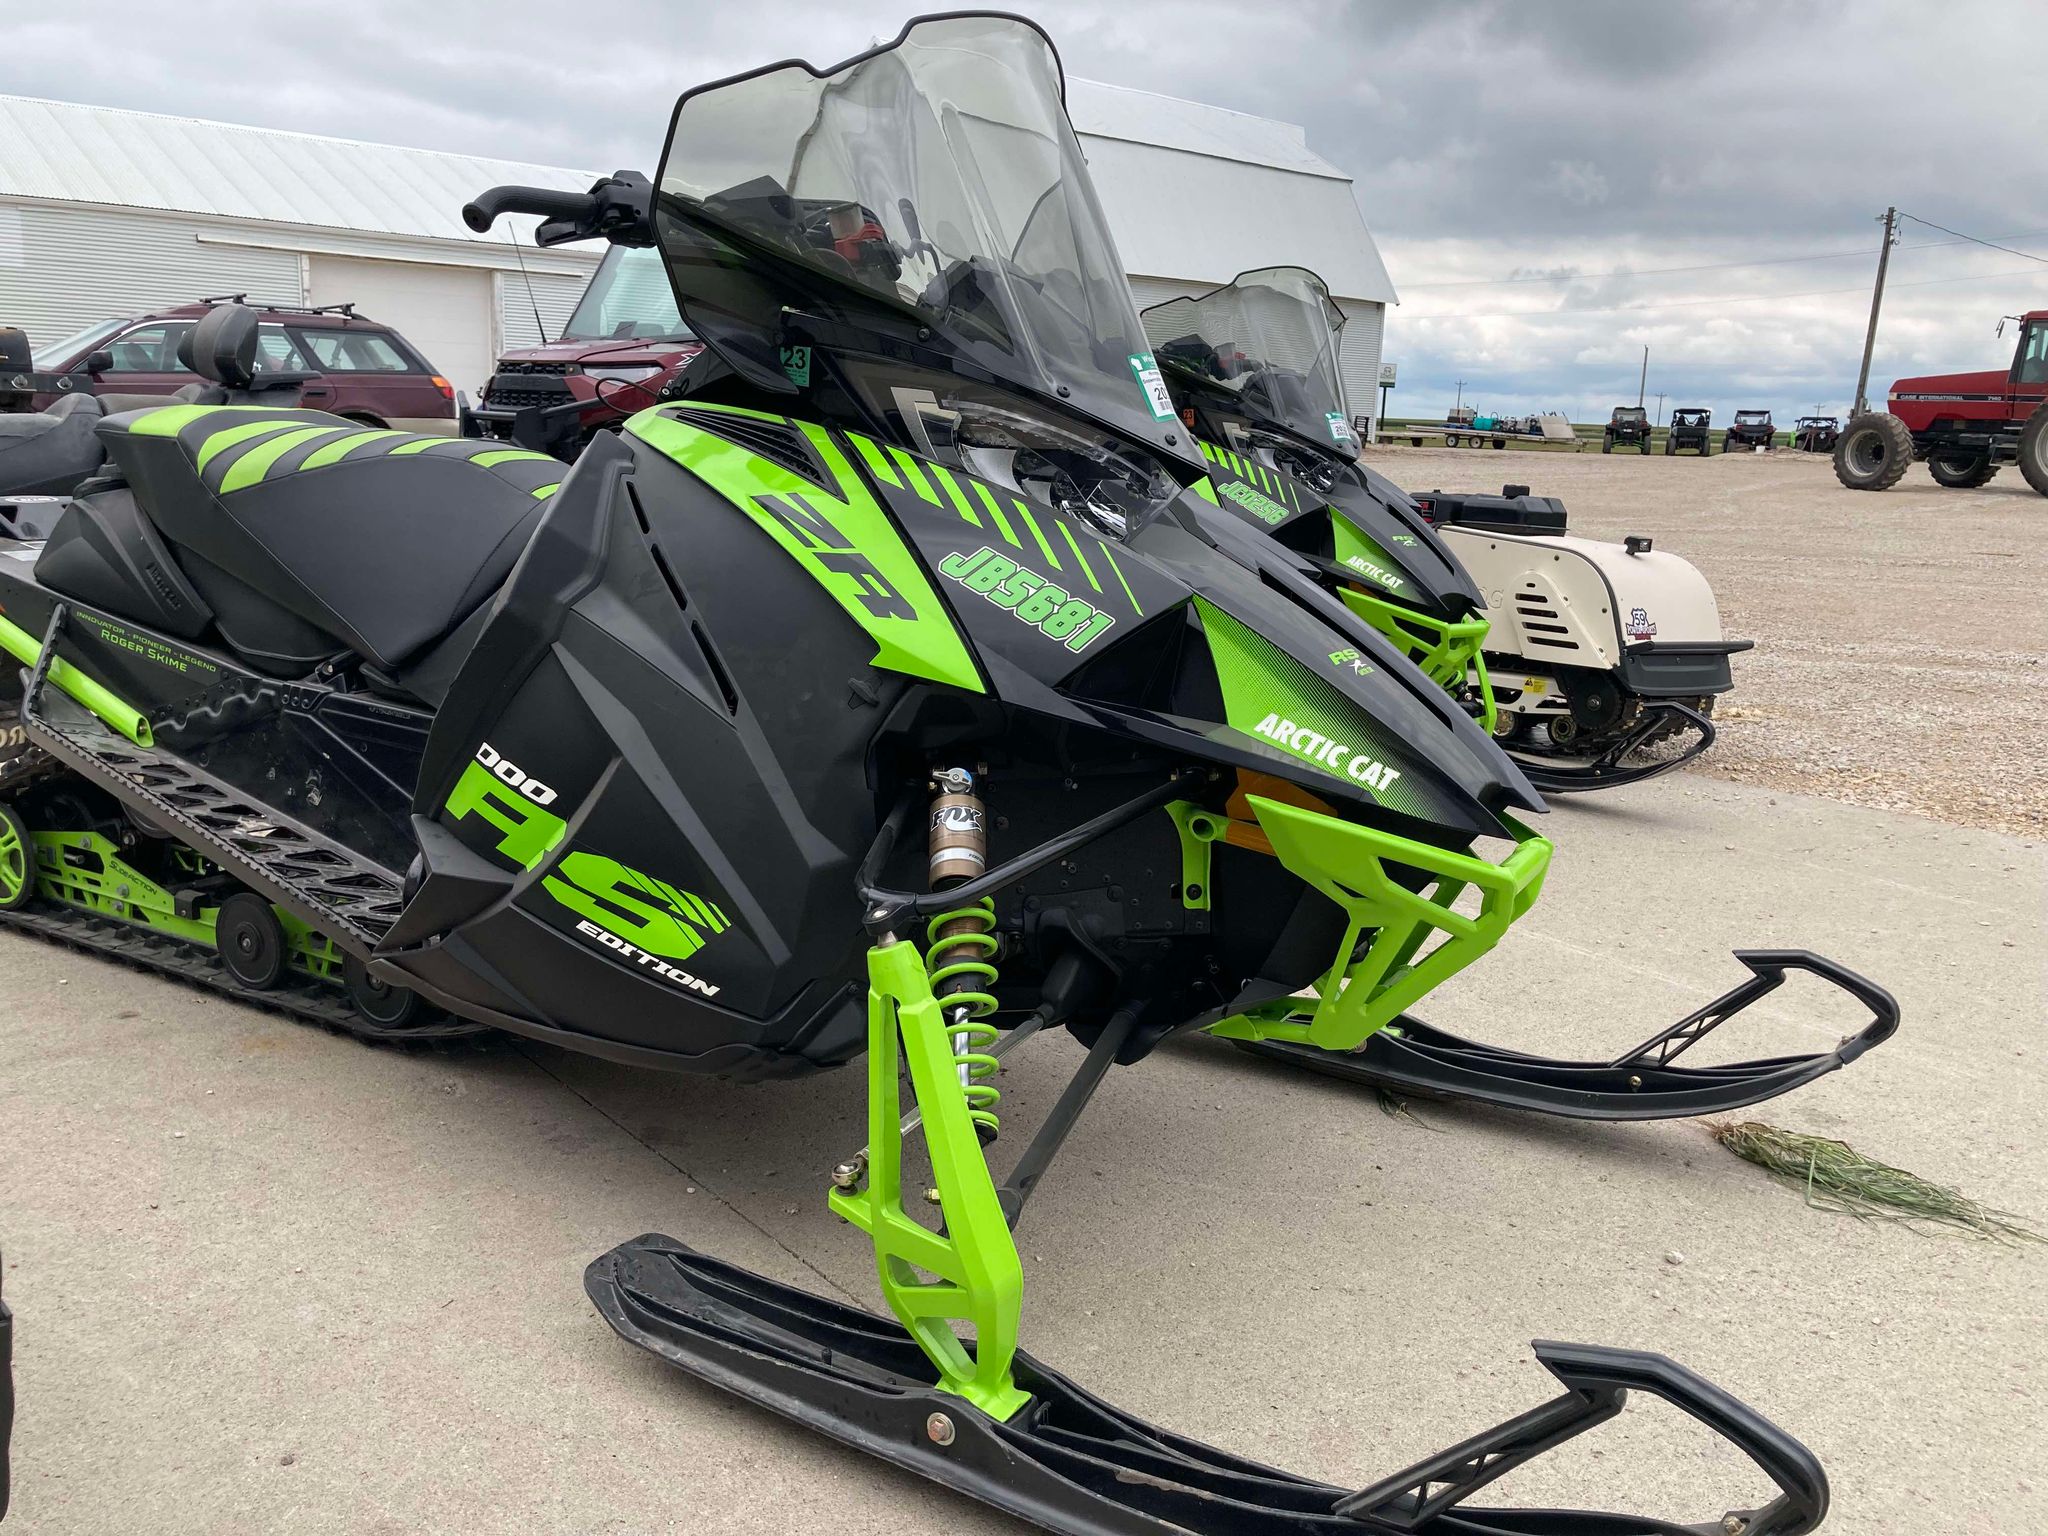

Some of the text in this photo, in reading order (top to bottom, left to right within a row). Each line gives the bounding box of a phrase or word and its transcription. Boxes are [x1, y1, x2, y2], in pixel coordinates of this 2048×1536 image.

[783, 347, 806, 369] 23
[749, 492, 919, 621] ZR
[1346, 555, 1404, 589] ARCTIC CAT
[938, 546, 1115, 653] JB5681
[1634, 613, 1646, 625] 59
[76, 611, 217, 672] INNOVATOR PIONEER LEGEND
[101, 629, 188, 672] ROGER SKIME
[1254, 712, 1401, 791] ARCTIC CAT
[931, 805, 982, 832] FOX
[576, 920, 720, 996] EDITION
